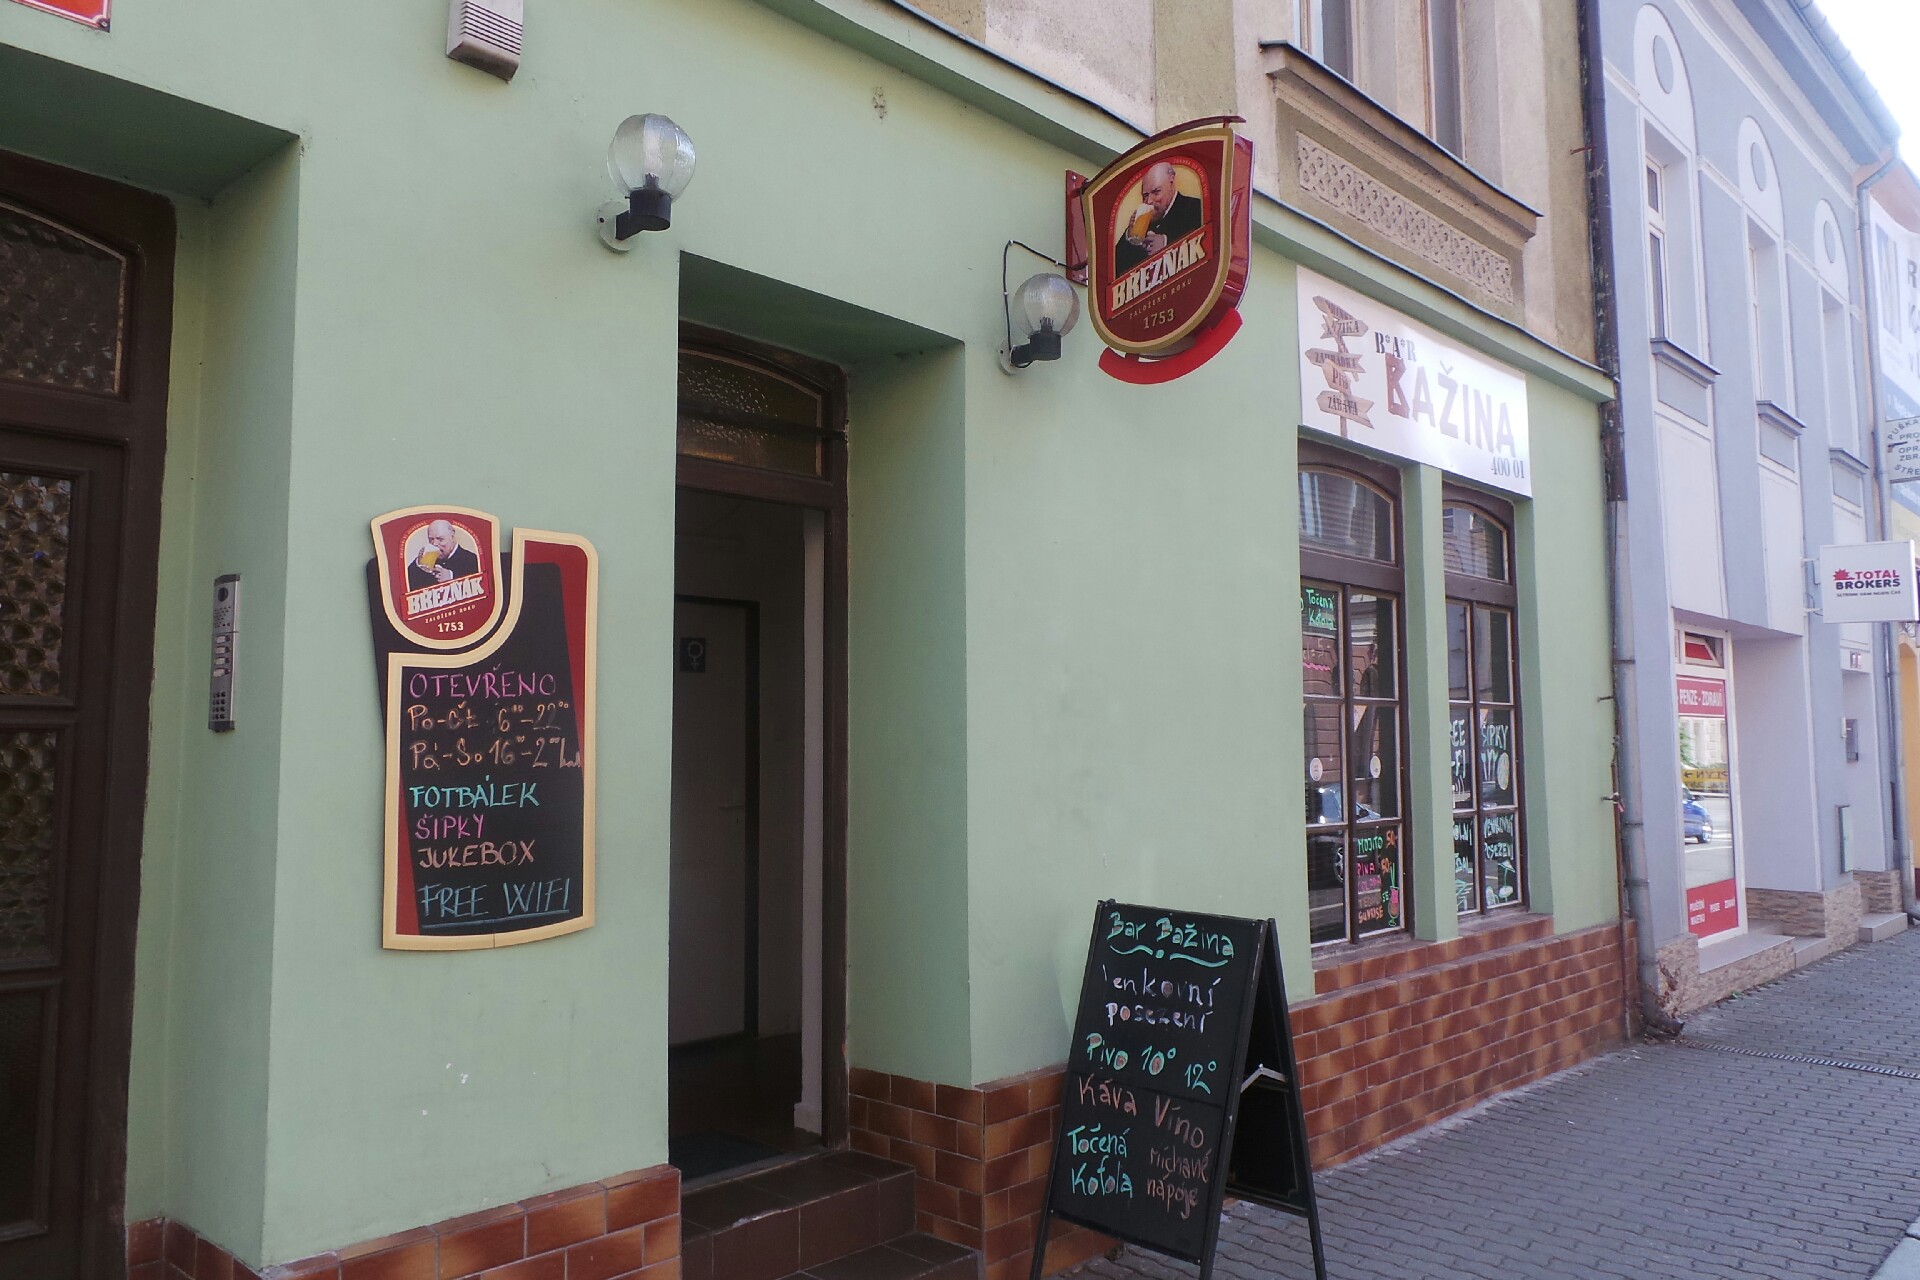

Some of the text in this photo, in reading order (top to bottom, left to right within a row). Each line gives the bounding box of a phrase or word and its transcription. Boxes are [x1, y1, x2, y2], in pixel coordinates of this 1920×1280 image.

[1143, 308, 1175, 329] 1753
[1385, 352, 1516, 458] BAŽINA
[1899, 445, 1920, 454] OPR
[1899, 453, 1920, 461] ZBR
[1491, 457, 1525, 478] 400 01
[1835, 578, 1901, 590] BROKERS
[1855, 570, 1900, 579] TOTAL
[459, 604, 476, 614] ROKU
[437, 621, 464, 633] 1753
[410, 664, 556, 698] OTEVŘENO
[1680, 688, 1699, 706] PENZE
[409, 775, 540, 808] FOTBÁLEK
[415, 814, 484, 839] ŠIPKY
[418, 840, 535, 868] JUKEBOX
[1357, 836, 1384, 854] MOJITO
[418, 878, 570, 918] FREE WIFI
[1107, 911, 1235, 958] Bar Bažina
[1086, 1033, 1129, 1070] Pivo
[1078, 1073, 1204, 1149] Káva Víno
[1067, 1123, 1131, 1158] Točená
[1071, 1155, 1133, 1199] Kofola
